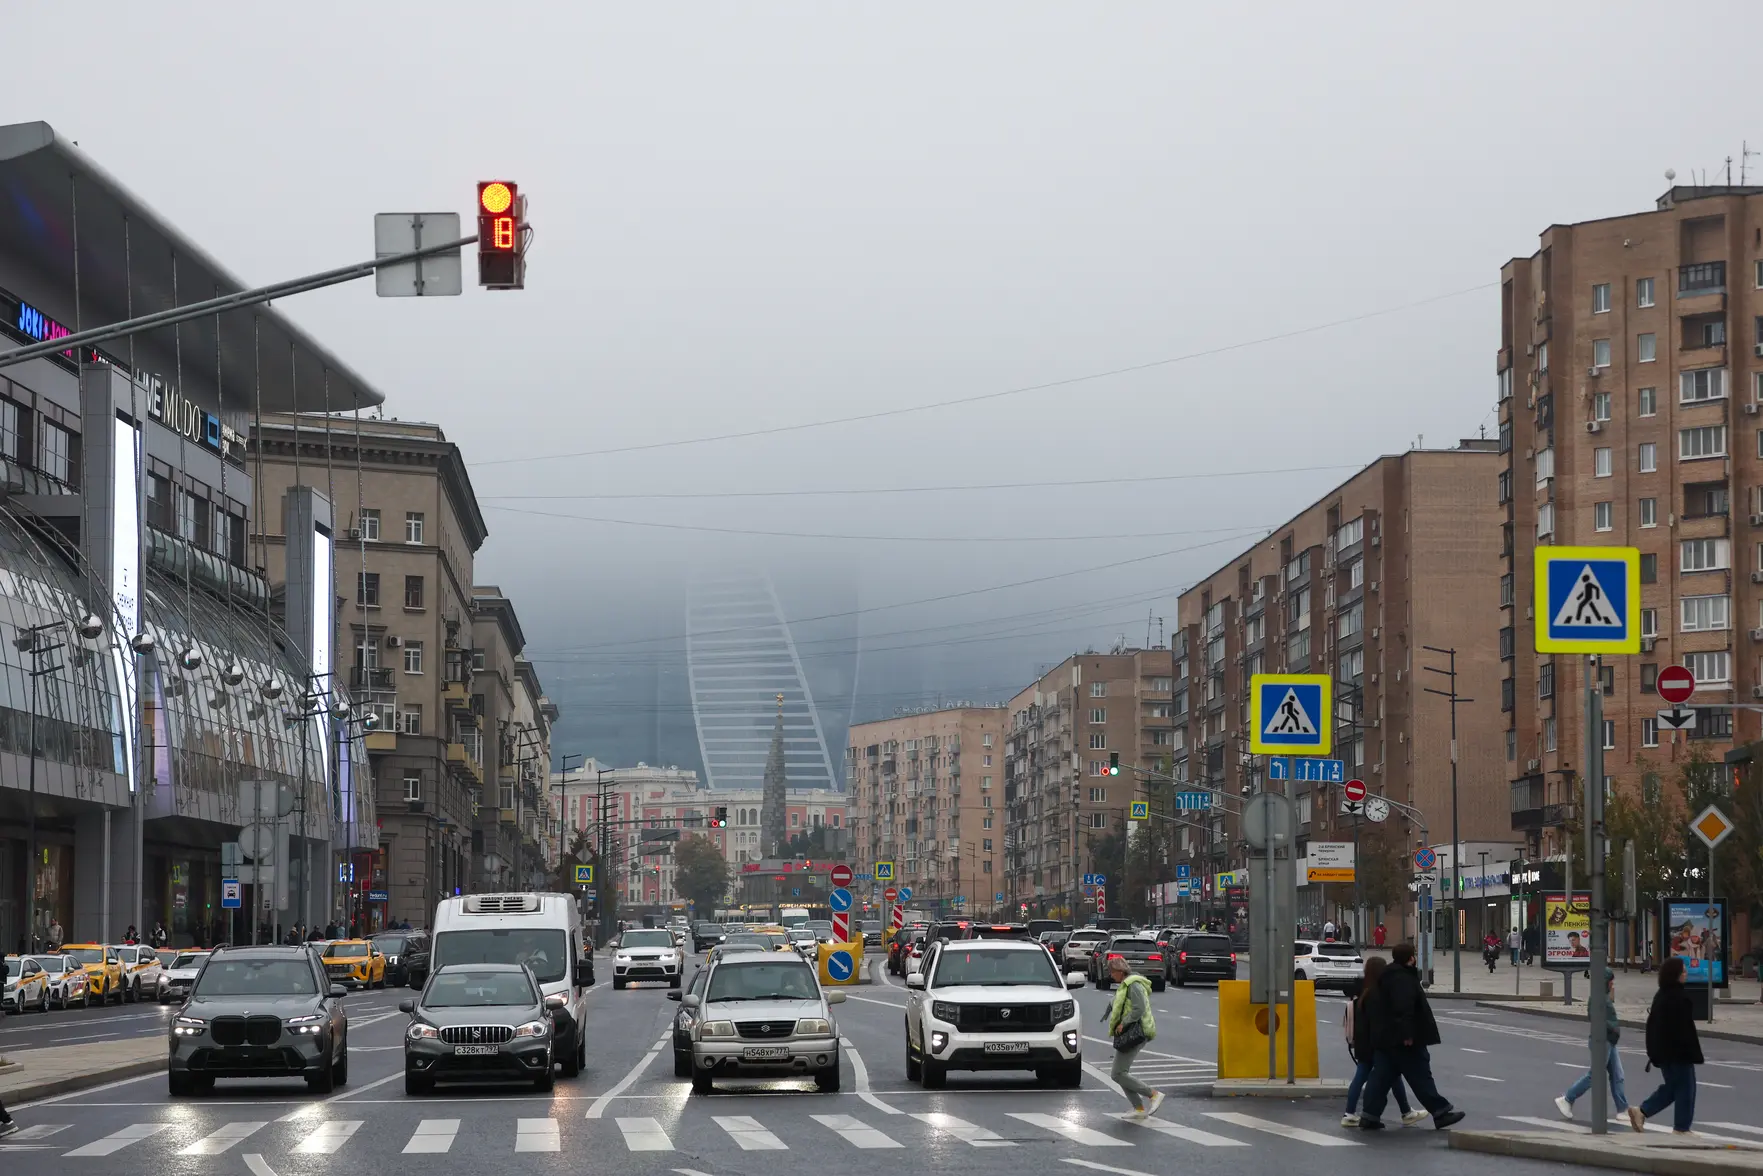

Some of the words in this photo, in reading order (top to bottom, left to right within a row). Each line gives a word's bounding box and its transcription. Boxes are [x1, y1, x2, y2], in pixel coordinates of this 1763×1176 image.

[494, 217, 513, 249] 18
[19, 302, 43, 341] JOKI
[163, 381, 201, 442] MUDO
